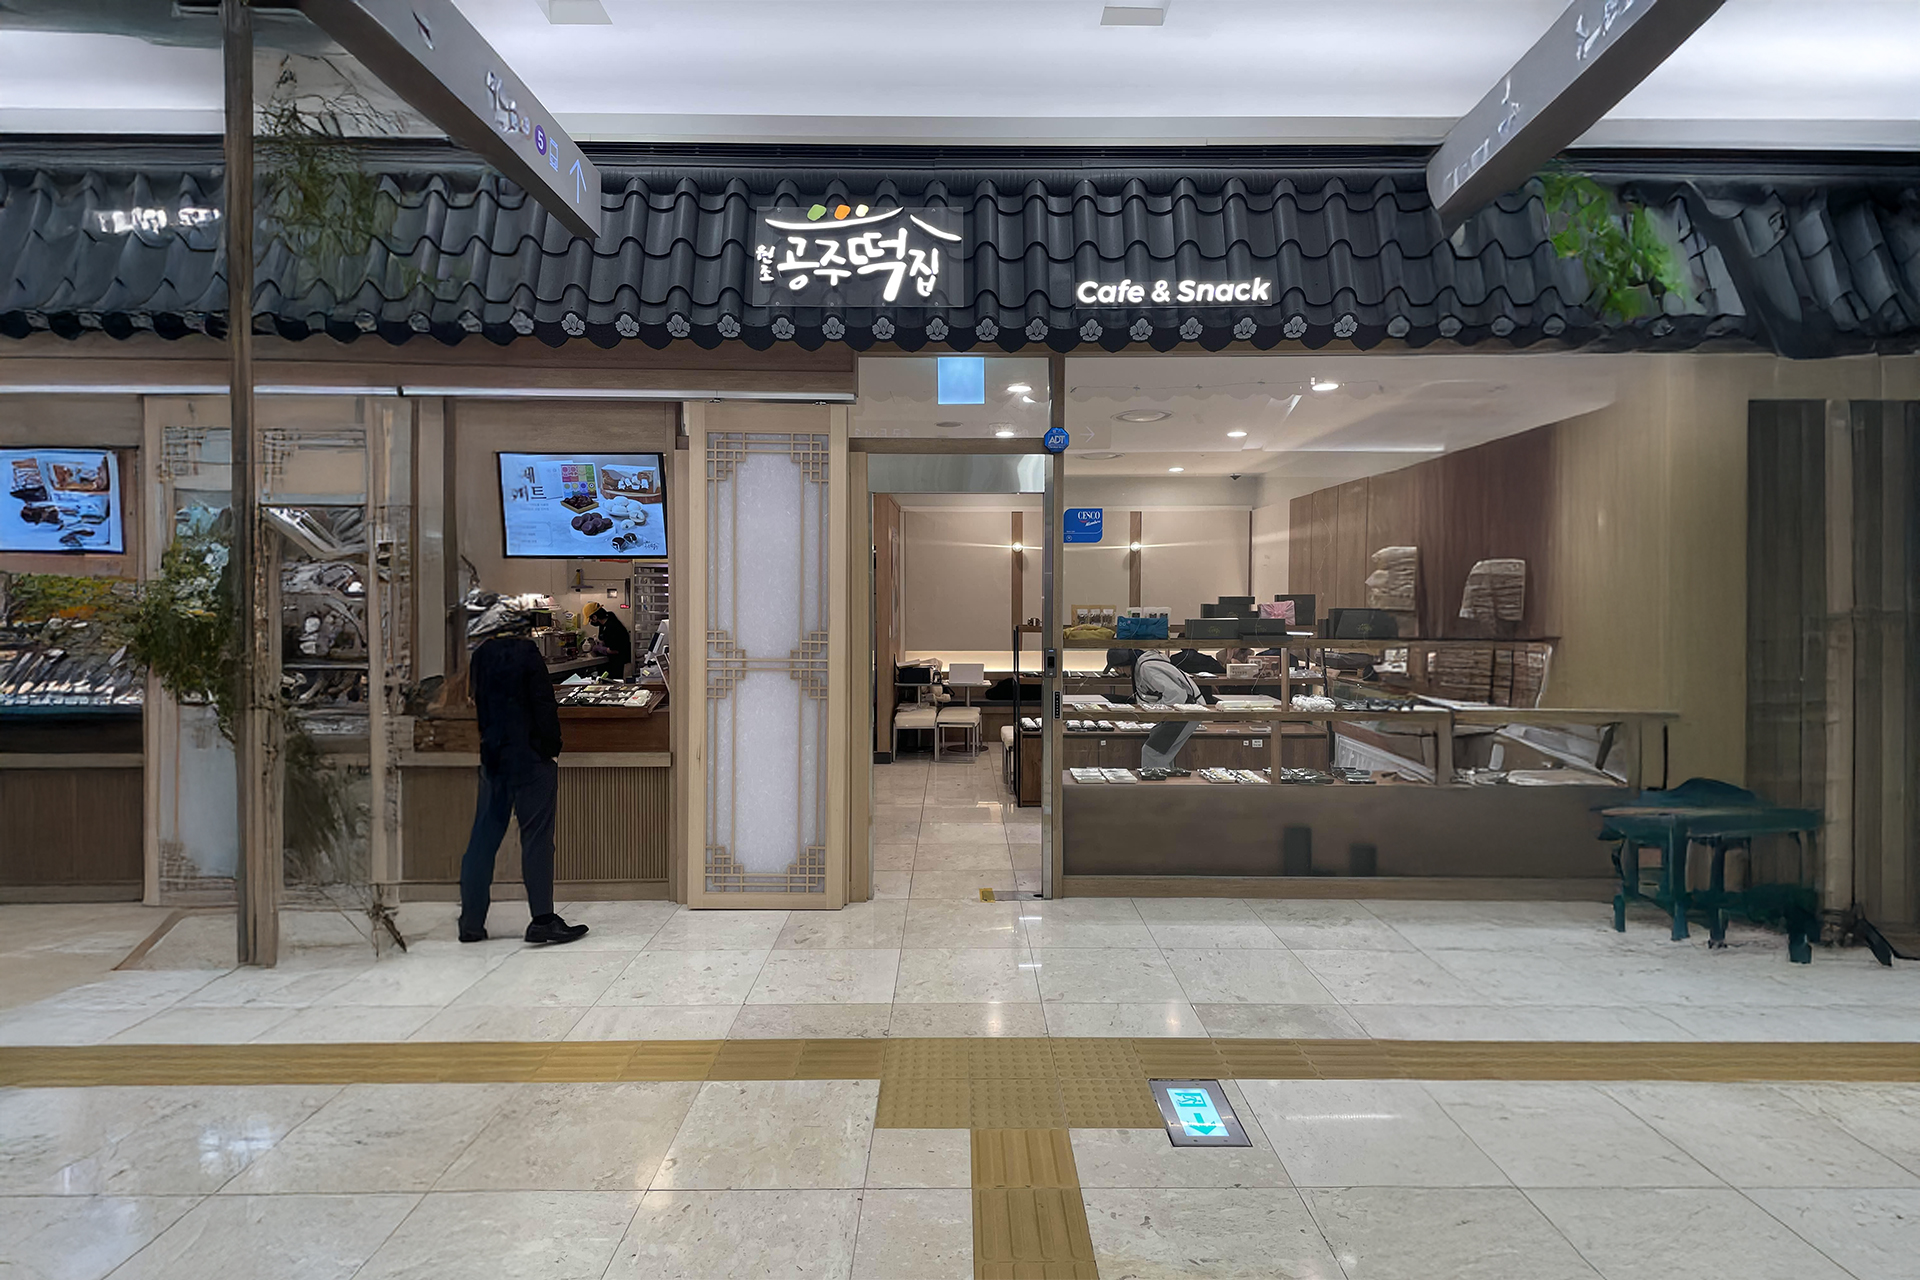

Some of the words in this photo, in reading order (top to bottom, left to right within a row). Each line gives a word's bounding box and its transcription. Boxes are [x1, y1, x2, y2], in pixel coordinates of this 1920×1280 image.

[755, 244, 775, 282] 원조
[776, 227, 939, 302] 공주떡집
[1076, 279, 1145, 304] Cafe
[1151, 279, 1171, 303] &
[1176, 277, 1271, 303] Snack
[1048, 435, 1066, 445] ADT
[1077, 510, 1101, 520] CESCO
